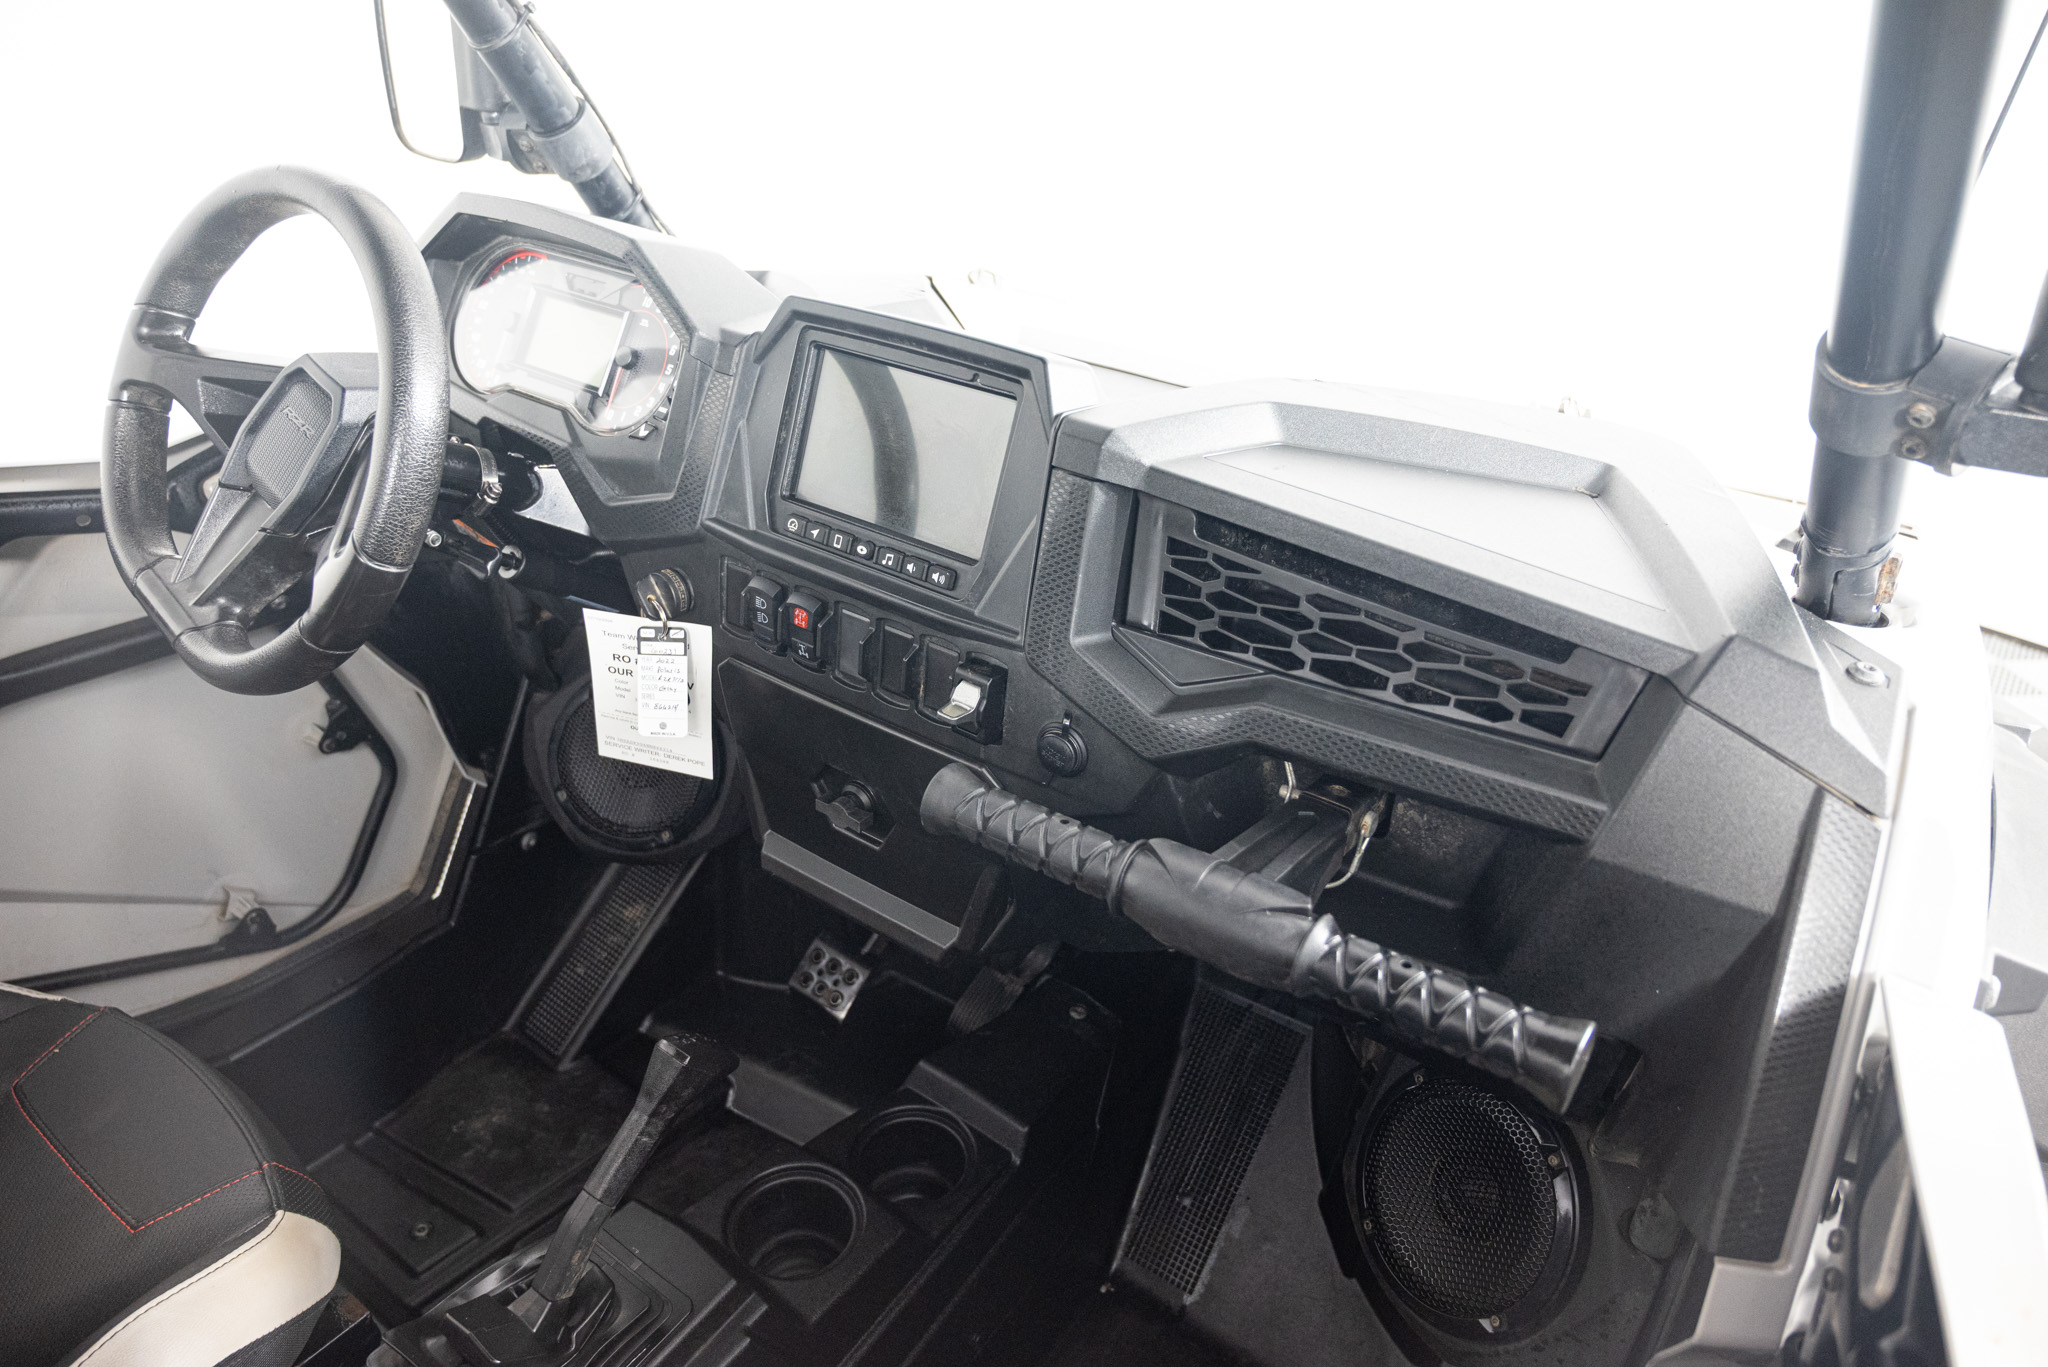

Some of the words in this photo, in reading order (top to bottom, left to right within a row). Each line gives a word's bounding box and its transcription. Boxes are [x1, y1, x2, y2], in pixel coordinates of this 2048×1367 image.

[669, 346, 677, 356] 6
[665, 364, 674, 376] 5
[634, 405, 642, 417] 2
[281, 406, 316, 439] RZR
[602, 630, 625, 639] Team
[612, 653, 631, 664] RO
[608, 666, 633, 677] OUR
[604, 740, 633, 751] SERVICE
[663, 753, 686, 763] DEREK
[687, 758, 706, 767] POPE
